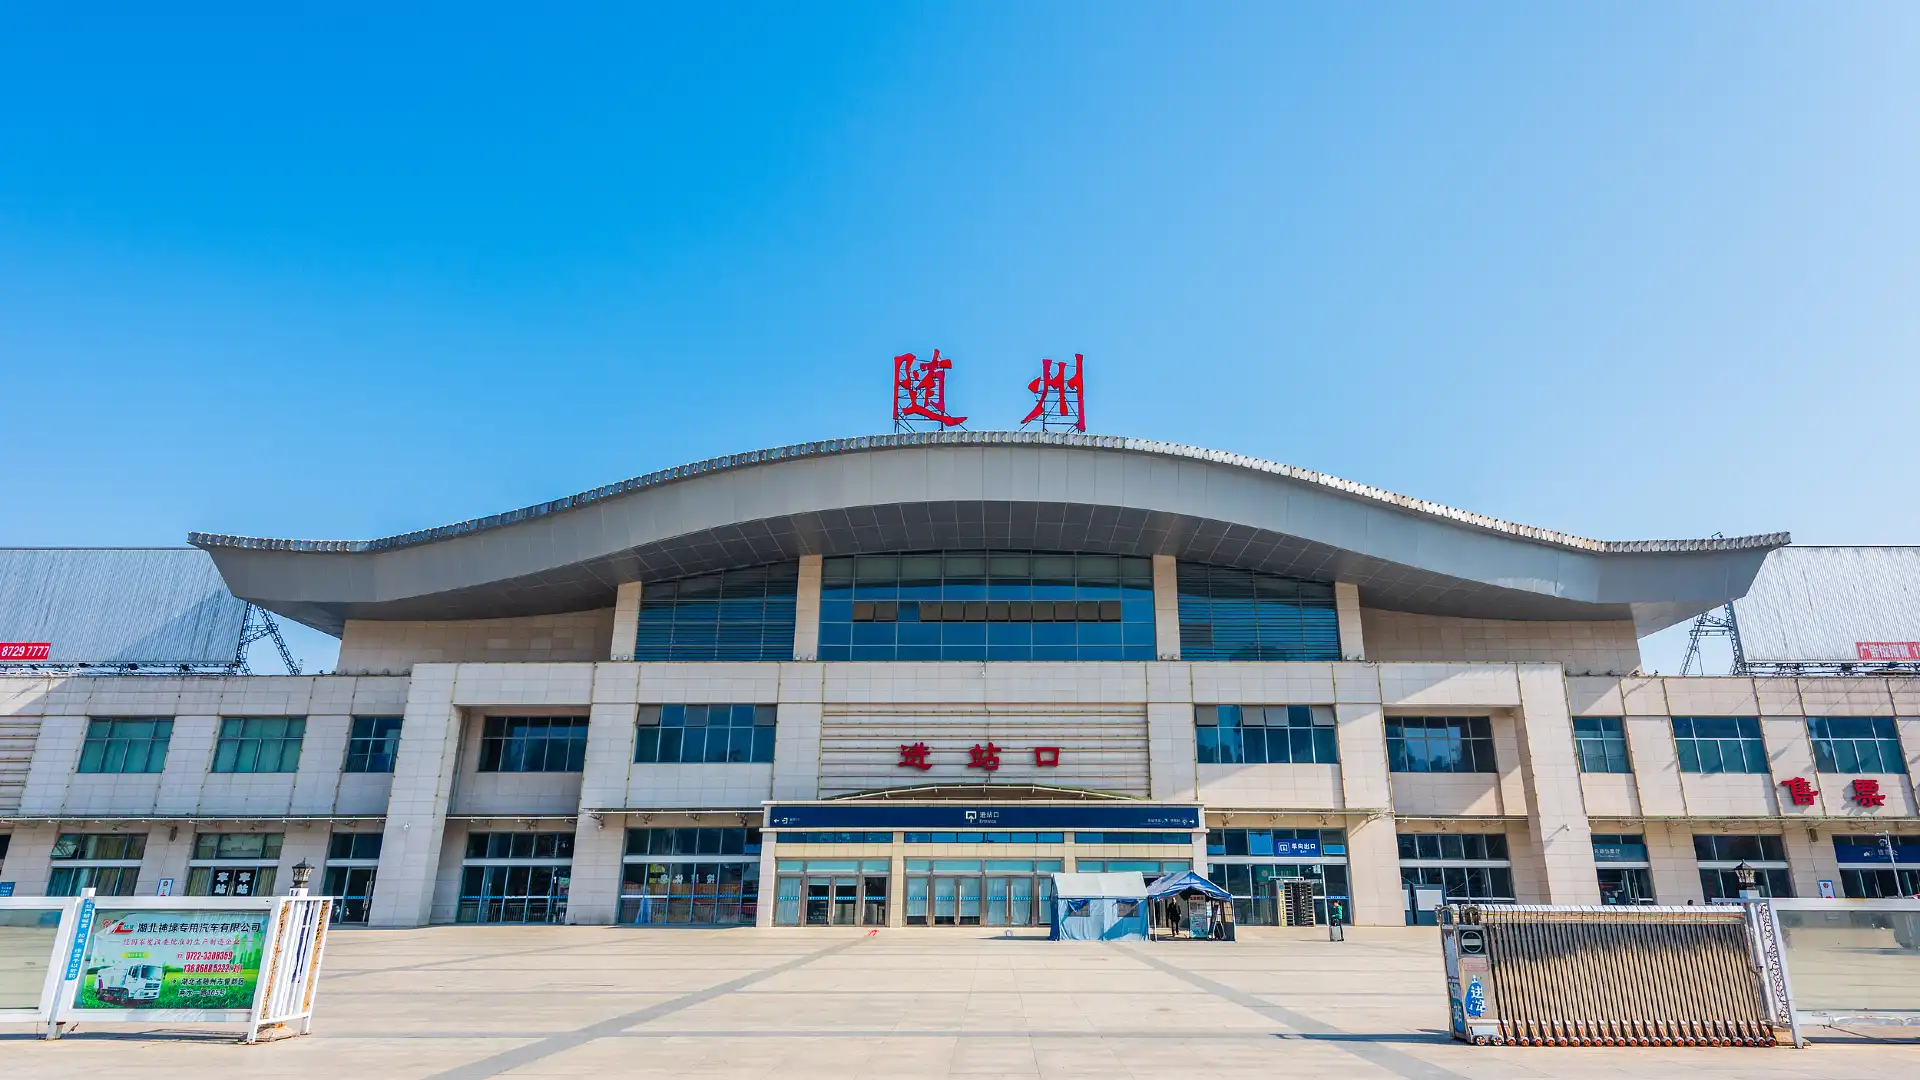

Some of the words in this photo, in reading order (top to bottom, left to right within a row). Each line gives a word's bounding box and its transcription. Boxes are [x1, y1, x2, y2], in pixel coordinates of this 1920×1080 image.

[893, 348, 1086, 432] 随州
[1, 645, 25, 657] 8729
[26, 645, 50, 657] 7777
[897, 741, 1060, 771] 进站口
[1779, 775, 1886, 808] 售票
[979, 810, 1000, 819] 进站口
